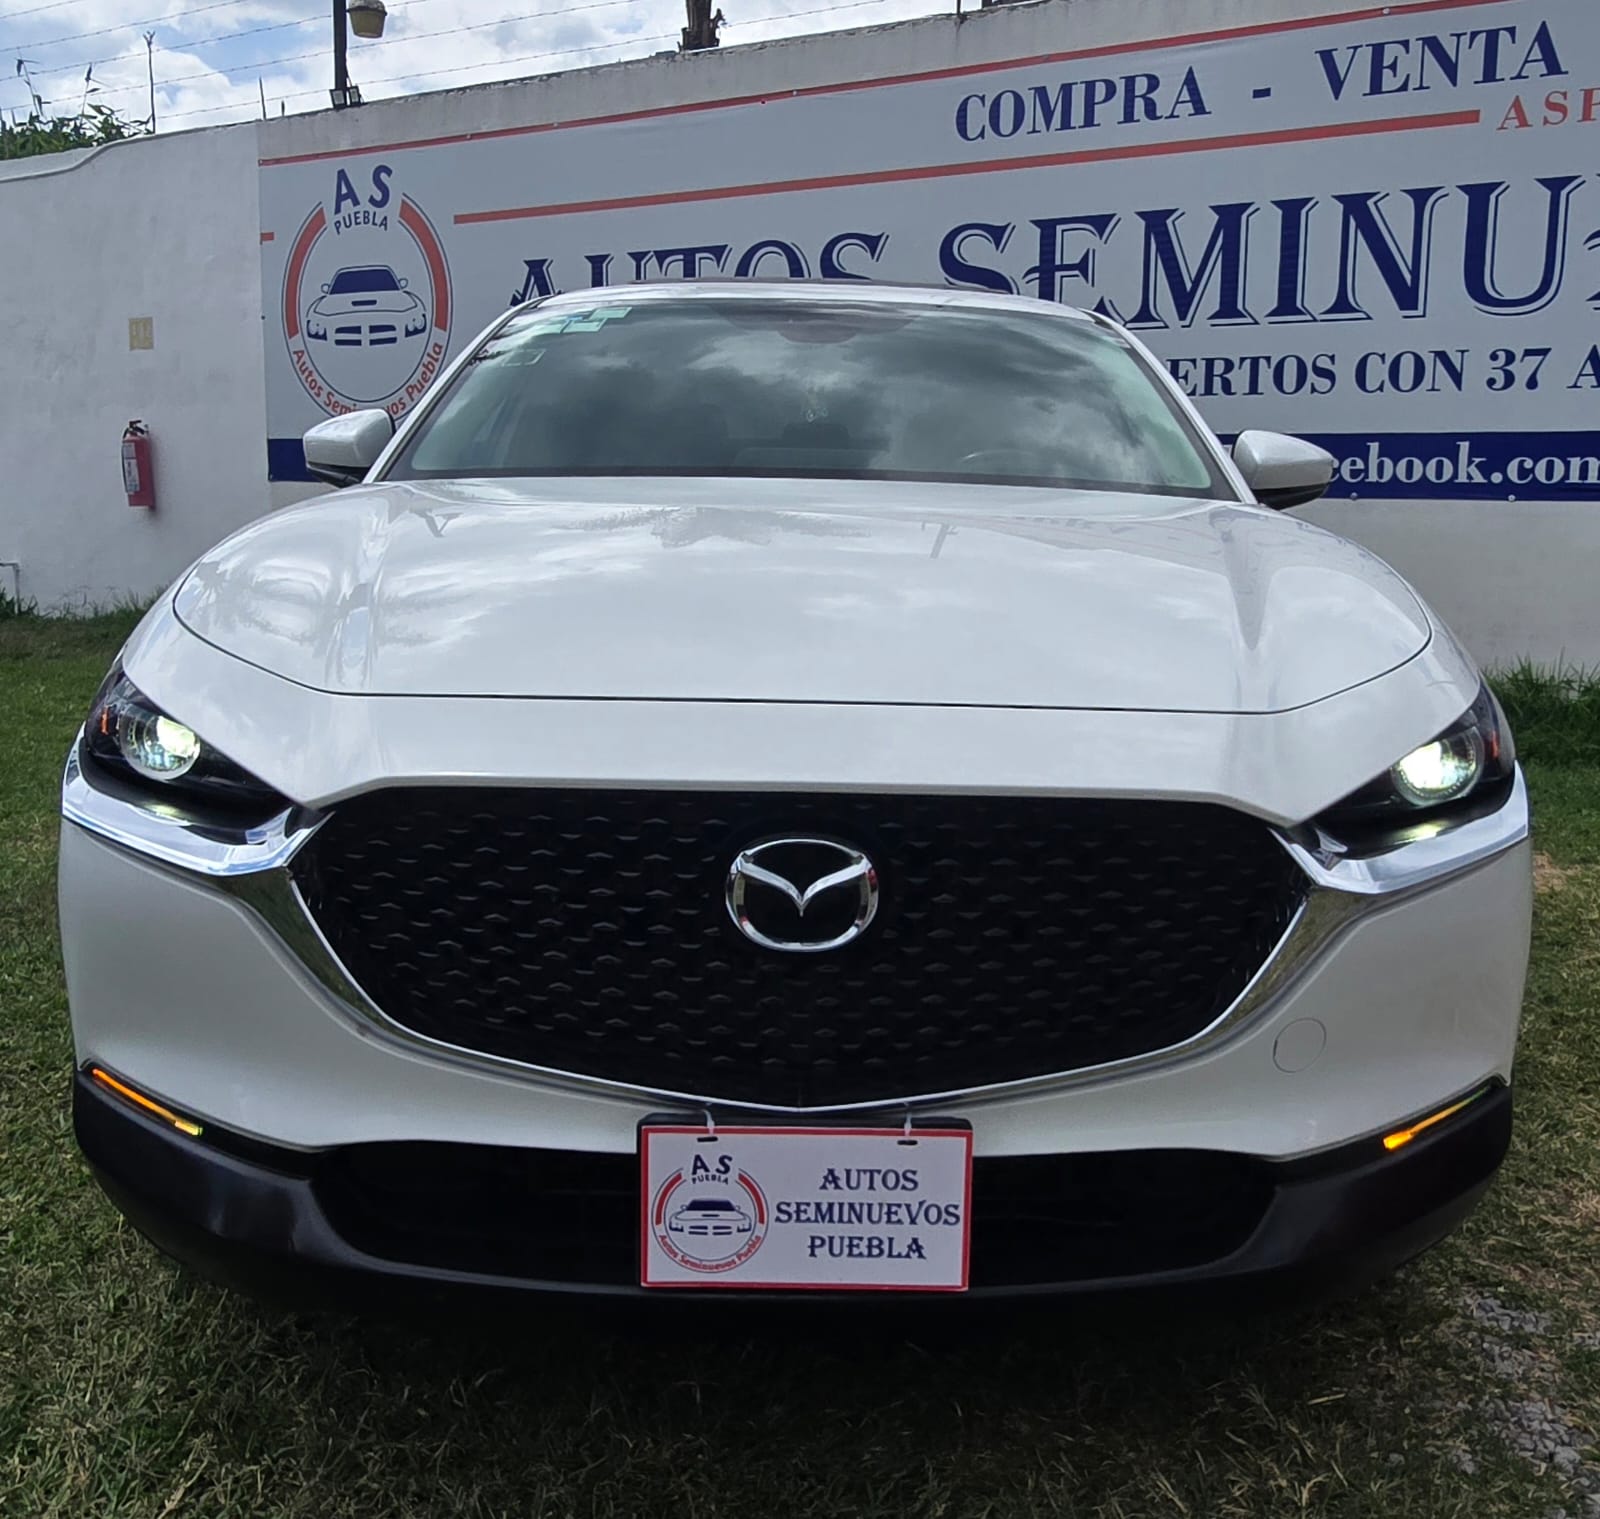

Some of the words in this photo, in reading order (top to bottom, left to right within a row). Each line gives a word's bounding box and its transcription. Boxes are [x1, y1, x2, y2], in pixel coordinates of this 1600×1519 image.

[955, 67, 1211, 141] COMPRA
[1315, 20, 1568, 101] VENTA
[334, 210, 389, 235] PUEBLA
[939, 174, 1600, 331] SEMINU
[293, 349, 323, 398] Autos
[405, 342, 443, 401] Puebla
[1355, 350, 1470, 394] CON
[1486, 348, 1552, 391] 37
[692, 1174, 729, 1185] PUEBLA
[819, 1168, 919, 1191] AUTOS
[774, 1200, 961, 1227] SEMINUEVOS
[807, 1235, 927, 1260] PUEBLA
